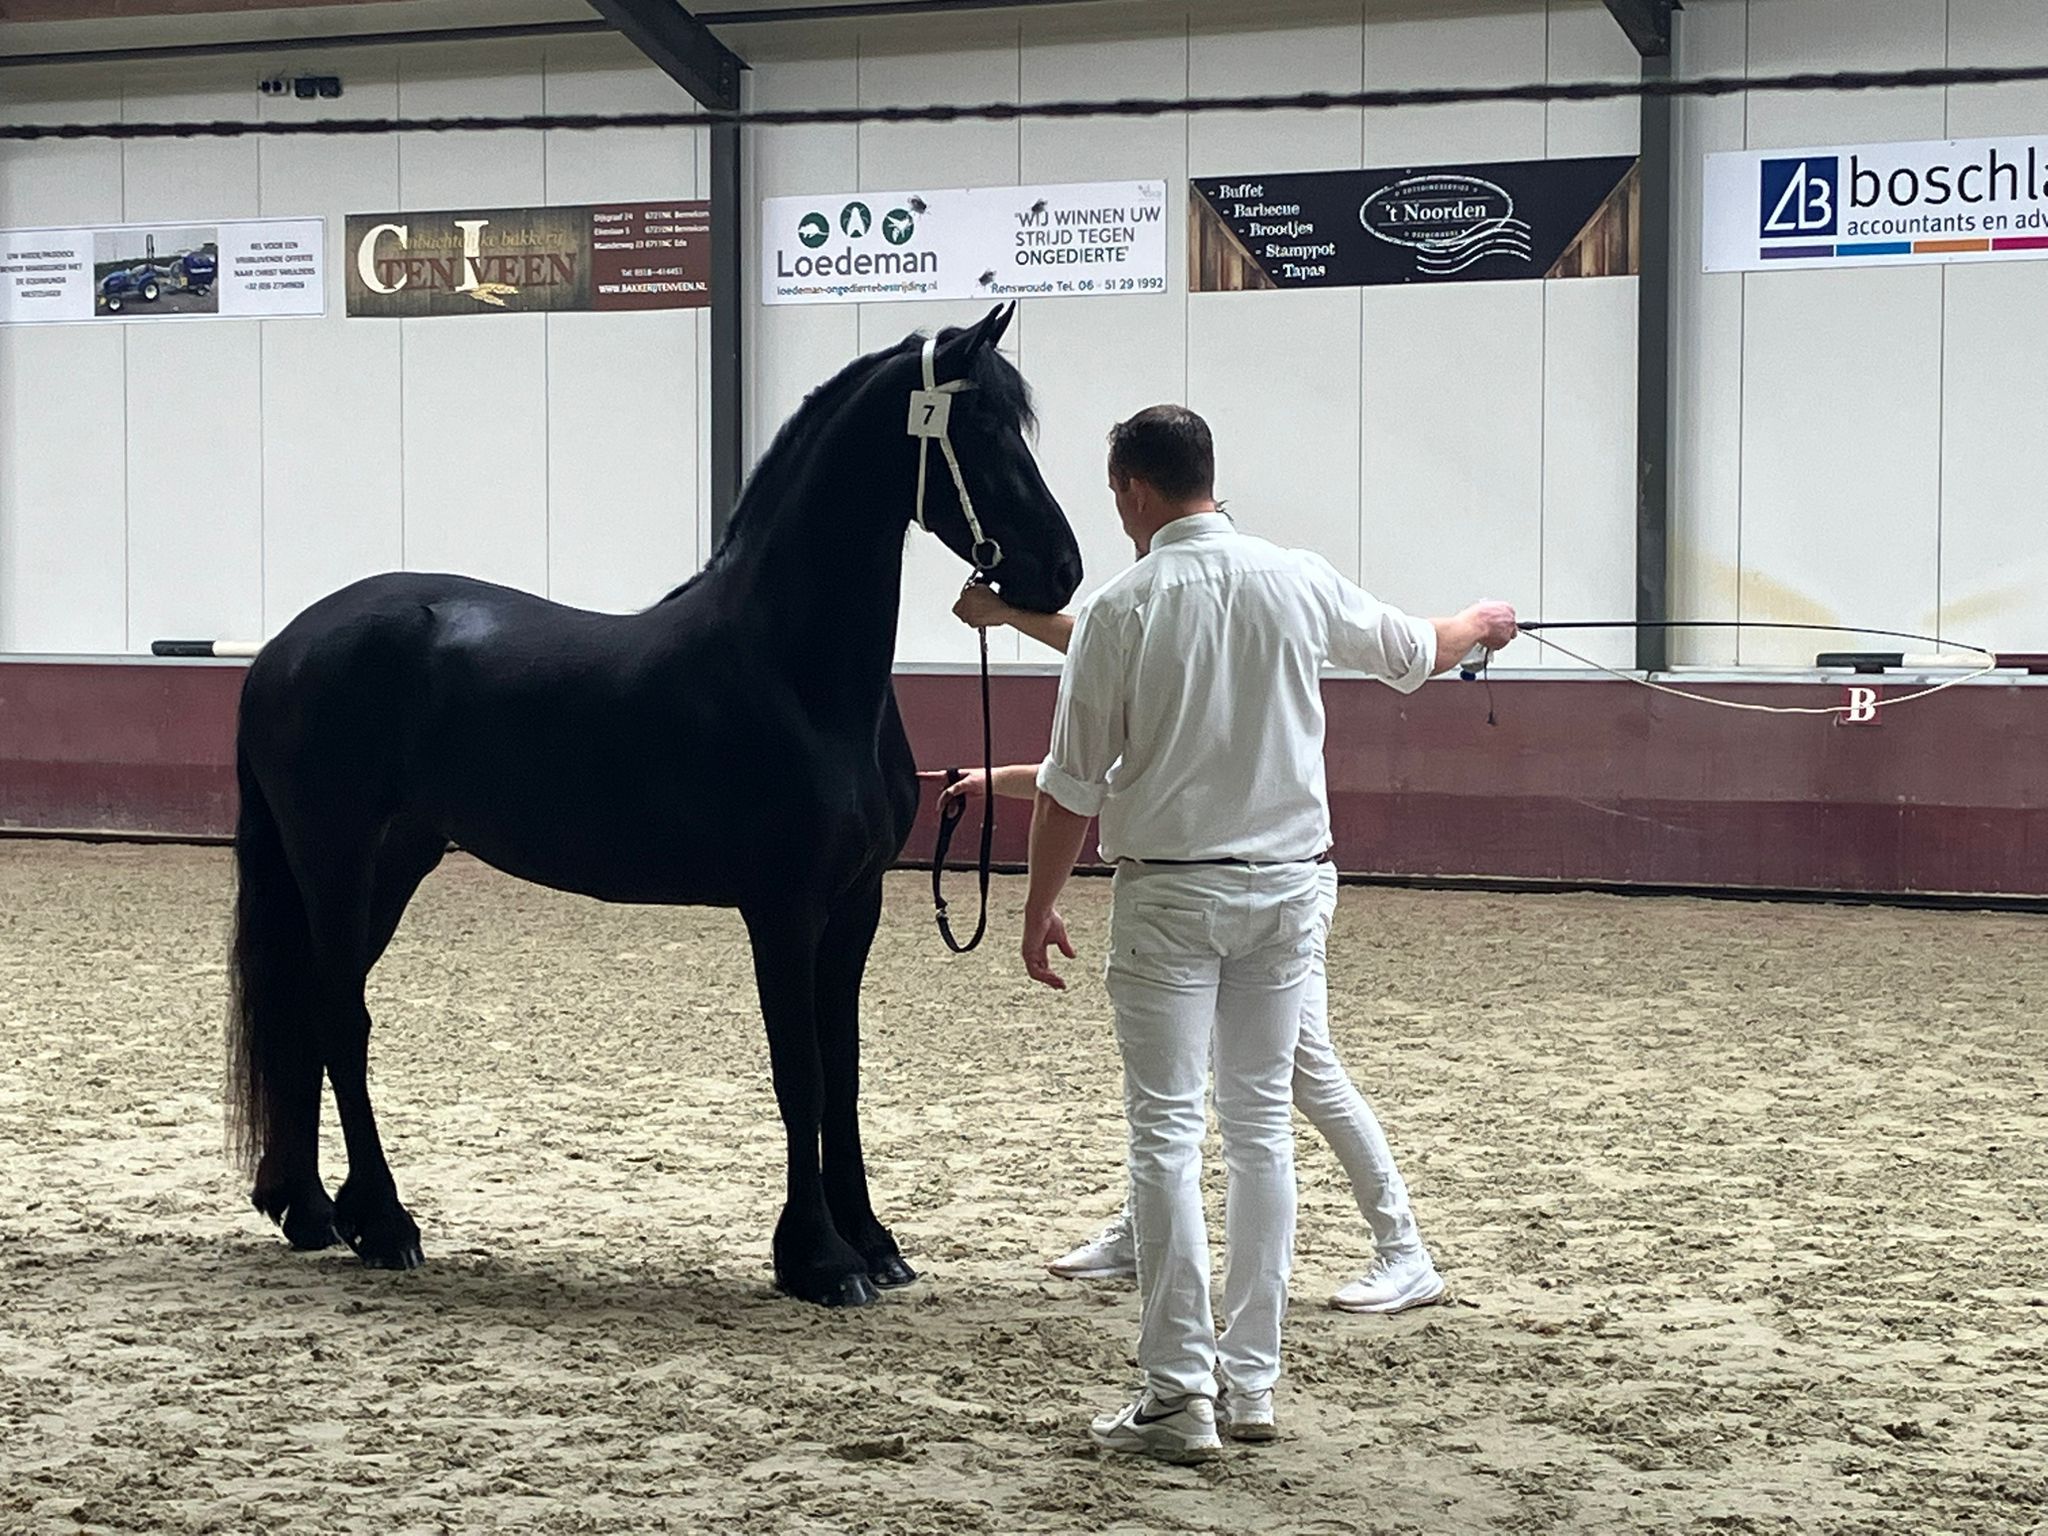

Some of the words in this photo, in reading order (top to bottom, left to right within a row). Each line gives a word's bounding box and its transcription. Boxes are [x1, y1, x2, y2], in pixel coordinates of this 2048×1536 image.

[1850, 147, 2048, 207] boschl
[1219, 184, 1264, 199] Buffet
[1054, 208, 1125, 226] WINNEN
[1130, 206, 1161, 222] UW
[1233, 203, 1300, 218] Barbecue
[1404, 201, 1486, 222] Noorden
[1249, 220, 1313, 239] Broodjes
[1848, 213, 1976, 236] accountants
[1982, 214, 2007, 230] en
[1015, 229, 1073, 247] STRIJD
[1078, 227, 1135, 244] TEGEN
[1265, 242, 1336, 260] Stamppot
[377, 256, 458, 291] TEN
[466, 252, 577, 287] VEEN
[777, 246, 937, 277] Loedeman
[1282, 263, 1326, 280] Tapas
[991, 281, 1053, 294] Renswoude
[1078, 279, 1094, 291] 06
[1105, 278, 1116, 289] 51
[1120, 277, 1133, 289] 29
[1137, 277, 1163, 289] 1992
[923, 404, 935, 425] 7
[1846, 687, 1877, 721] B
